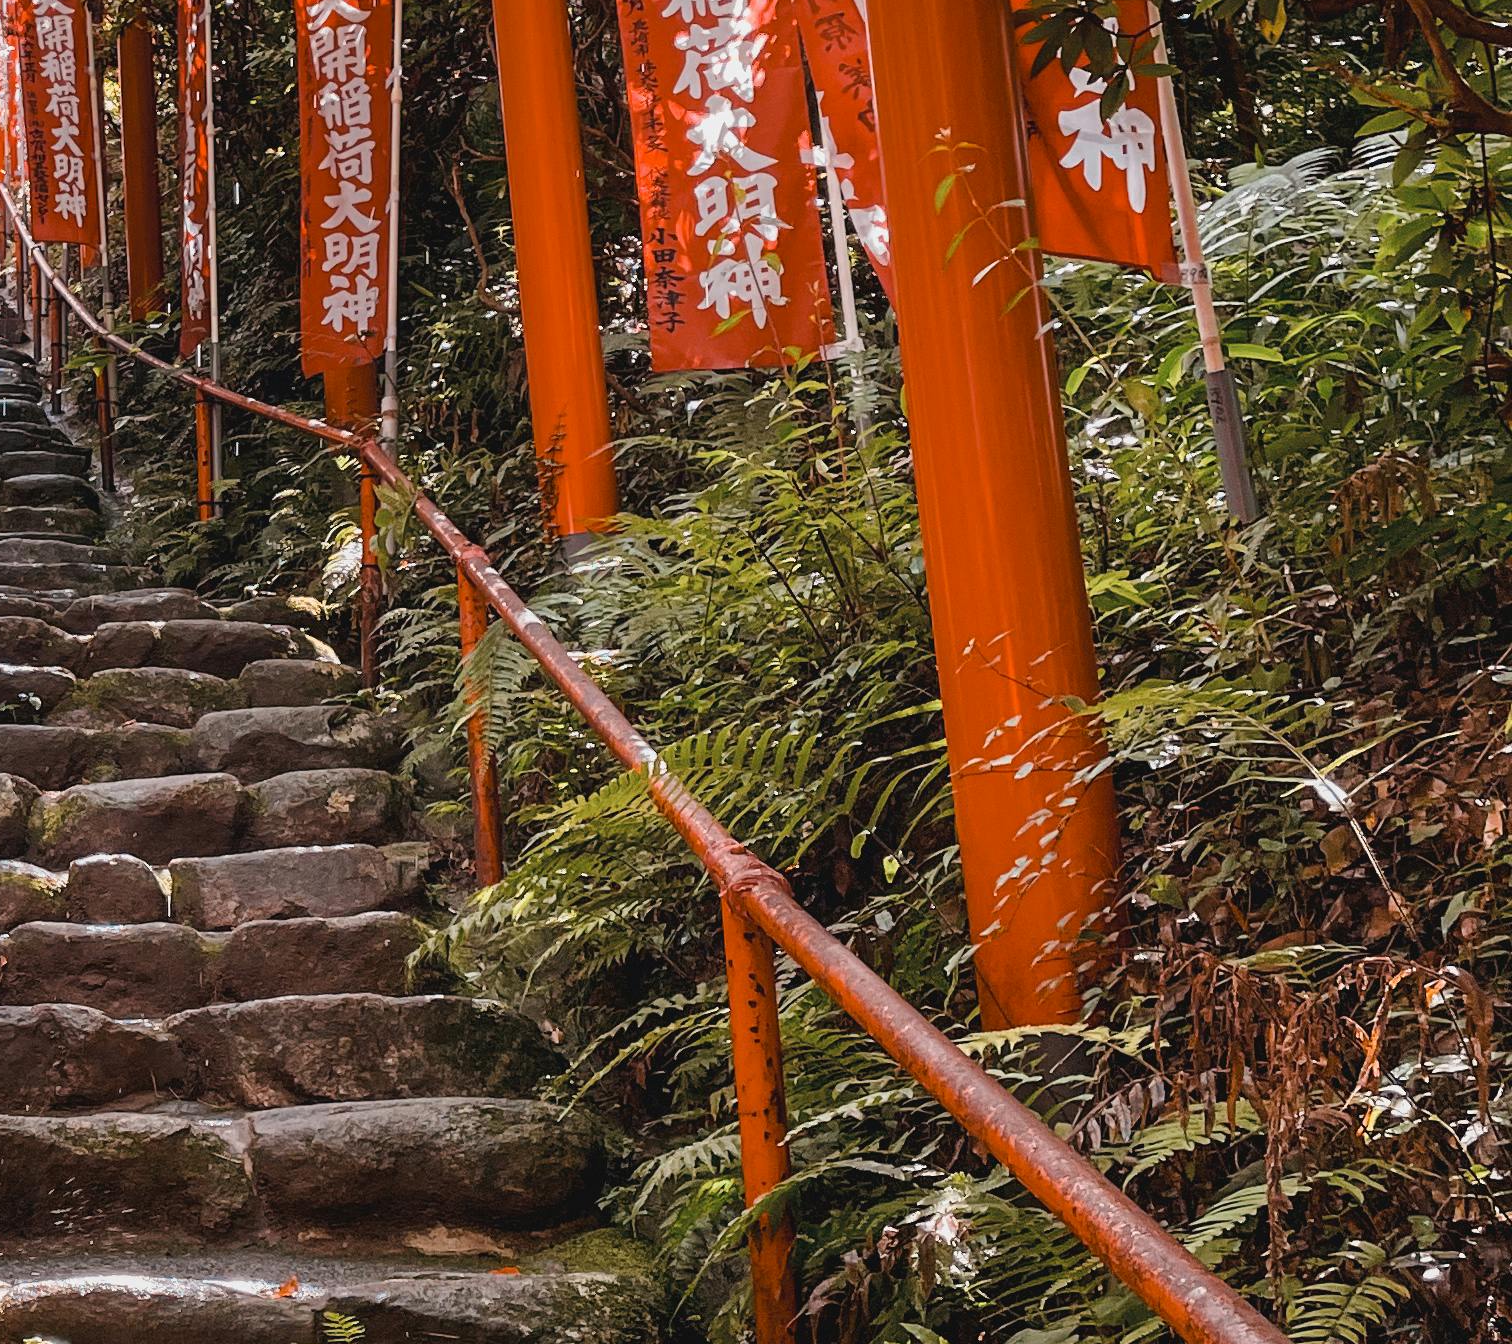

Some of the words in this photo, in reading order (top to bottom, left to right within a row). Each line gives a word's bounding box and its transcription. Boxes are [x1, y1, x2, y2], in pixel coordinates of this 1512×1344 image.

[646, 227, 687, 334] 小田奈津子
